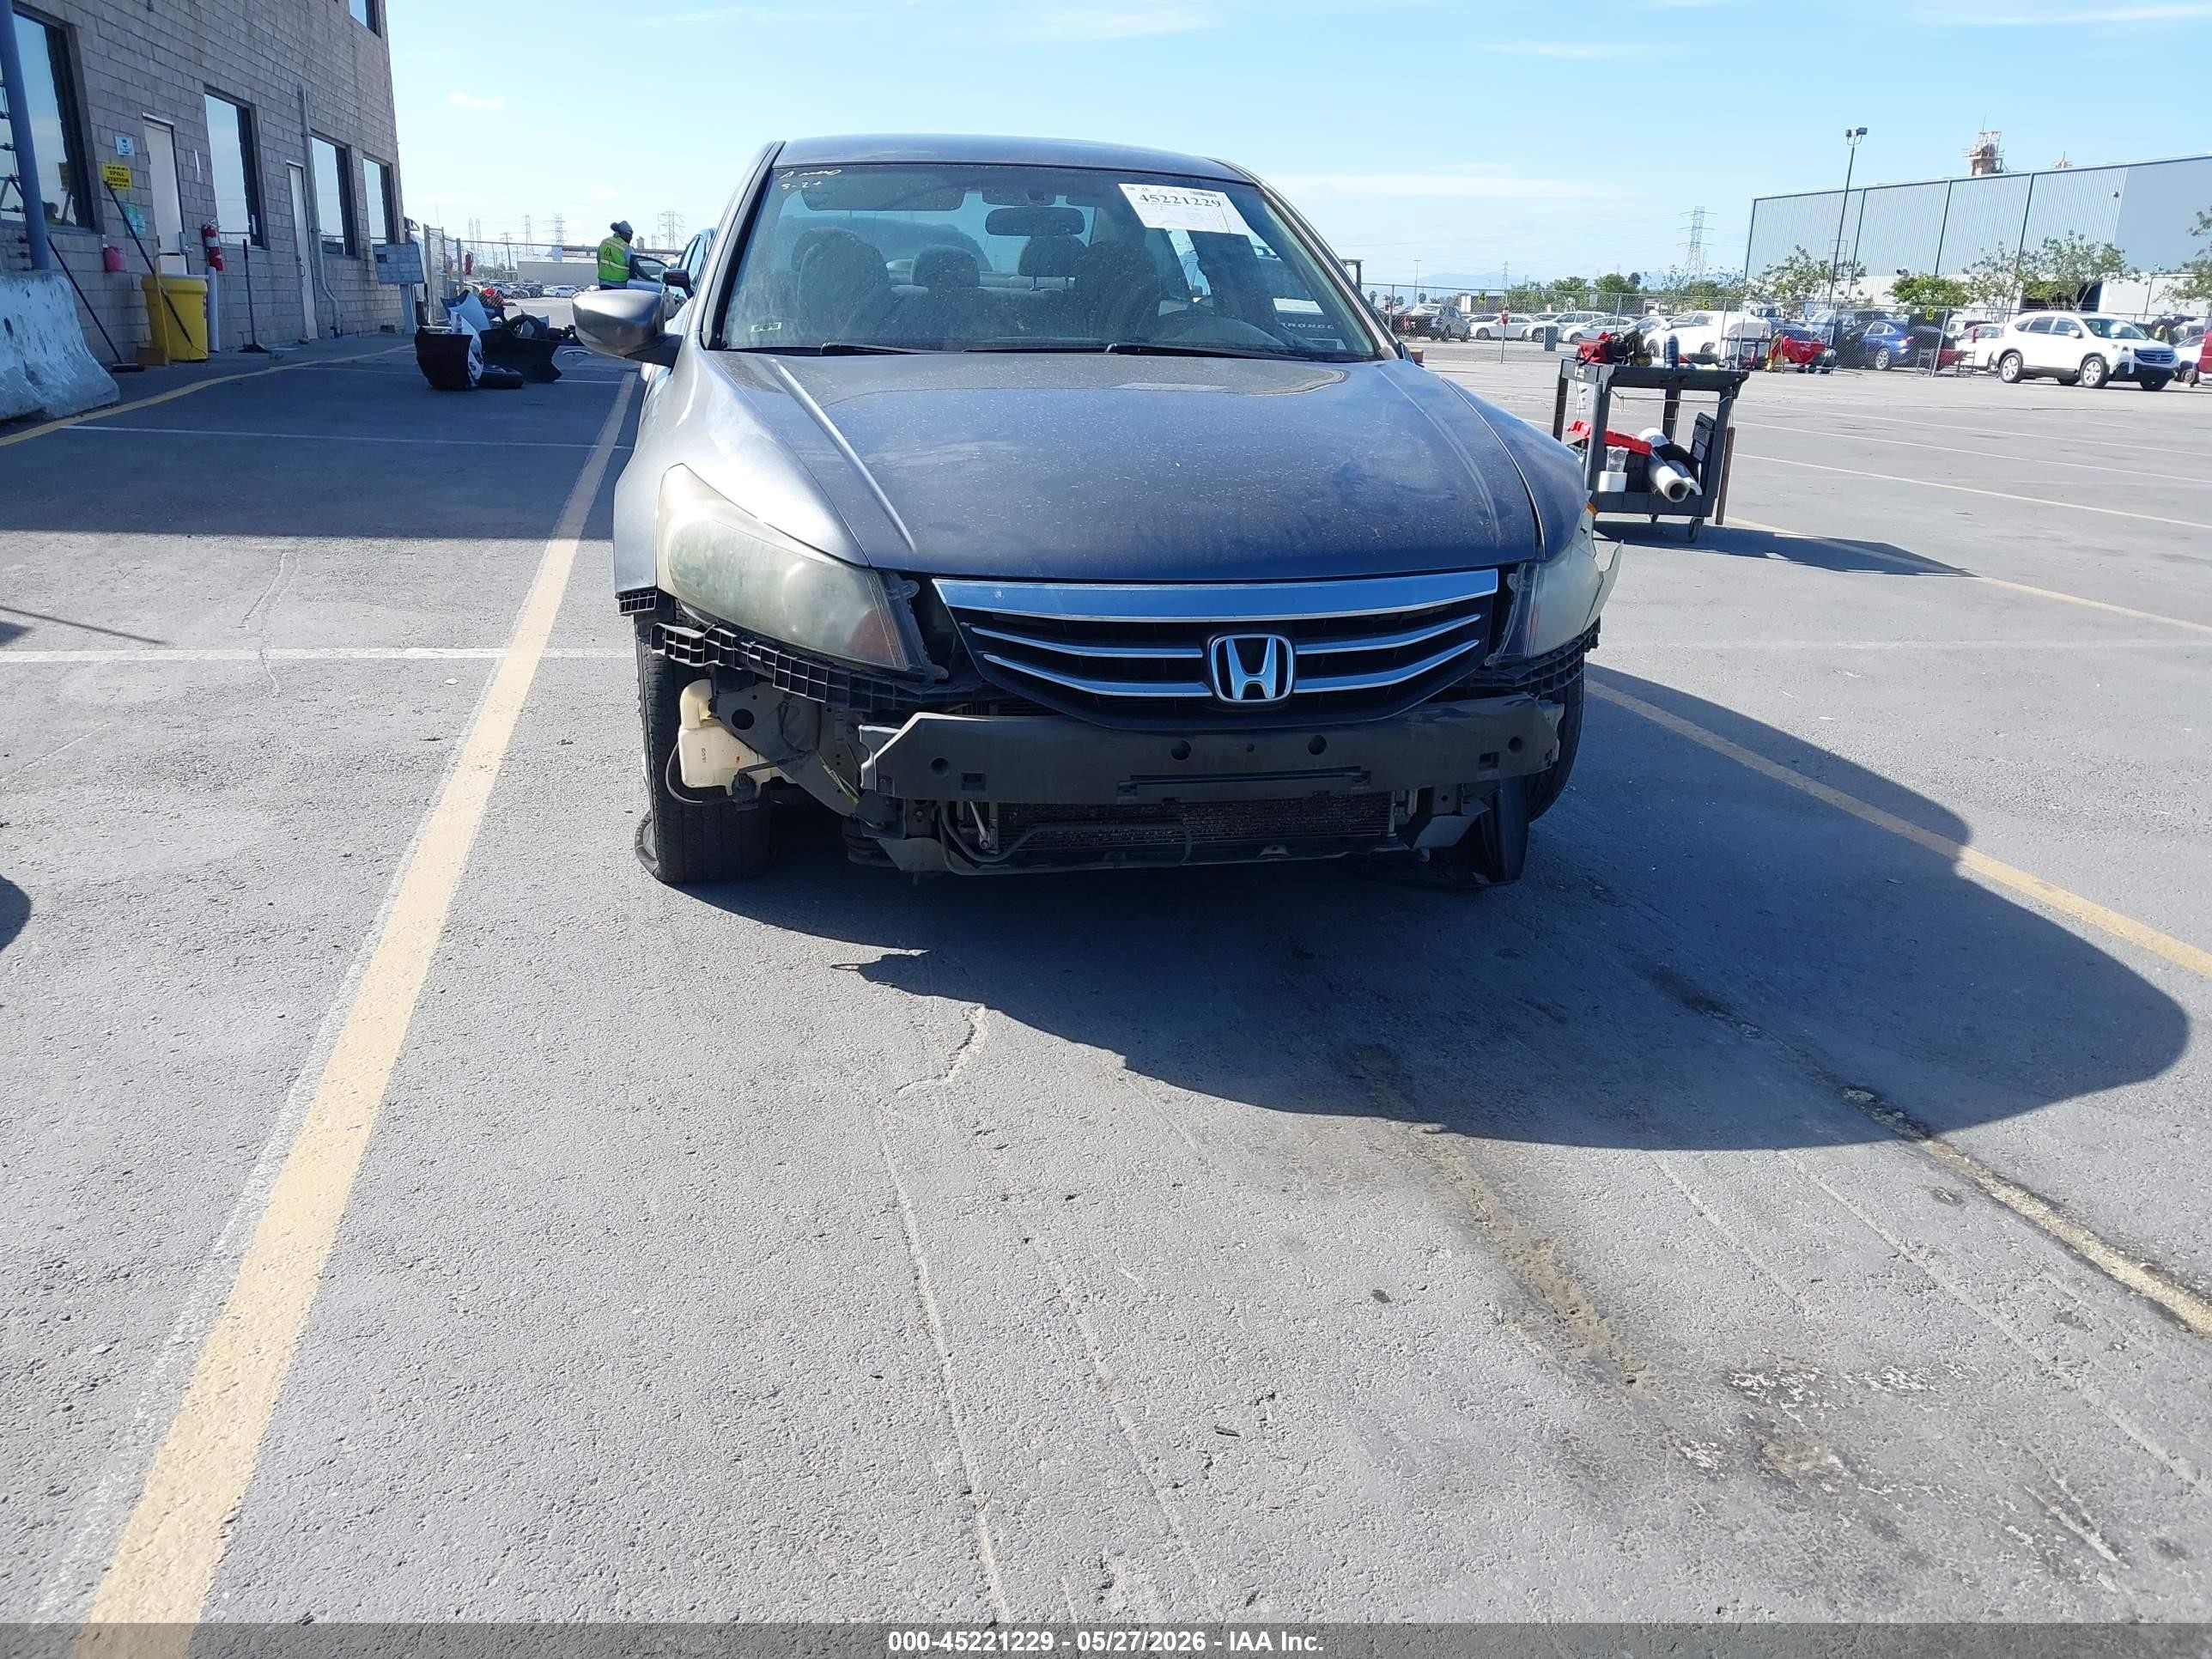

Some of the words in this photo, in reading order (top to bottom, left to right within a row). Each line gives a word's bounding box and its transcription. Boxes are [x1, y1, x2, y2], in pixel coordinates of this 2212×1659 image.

[1139, 194, 1222, 207] 45221229
[1479, 292, 1486, 302] 4
[1704, 300, 1710, 310] 5
[1927, 308, 1934, 318] 6
